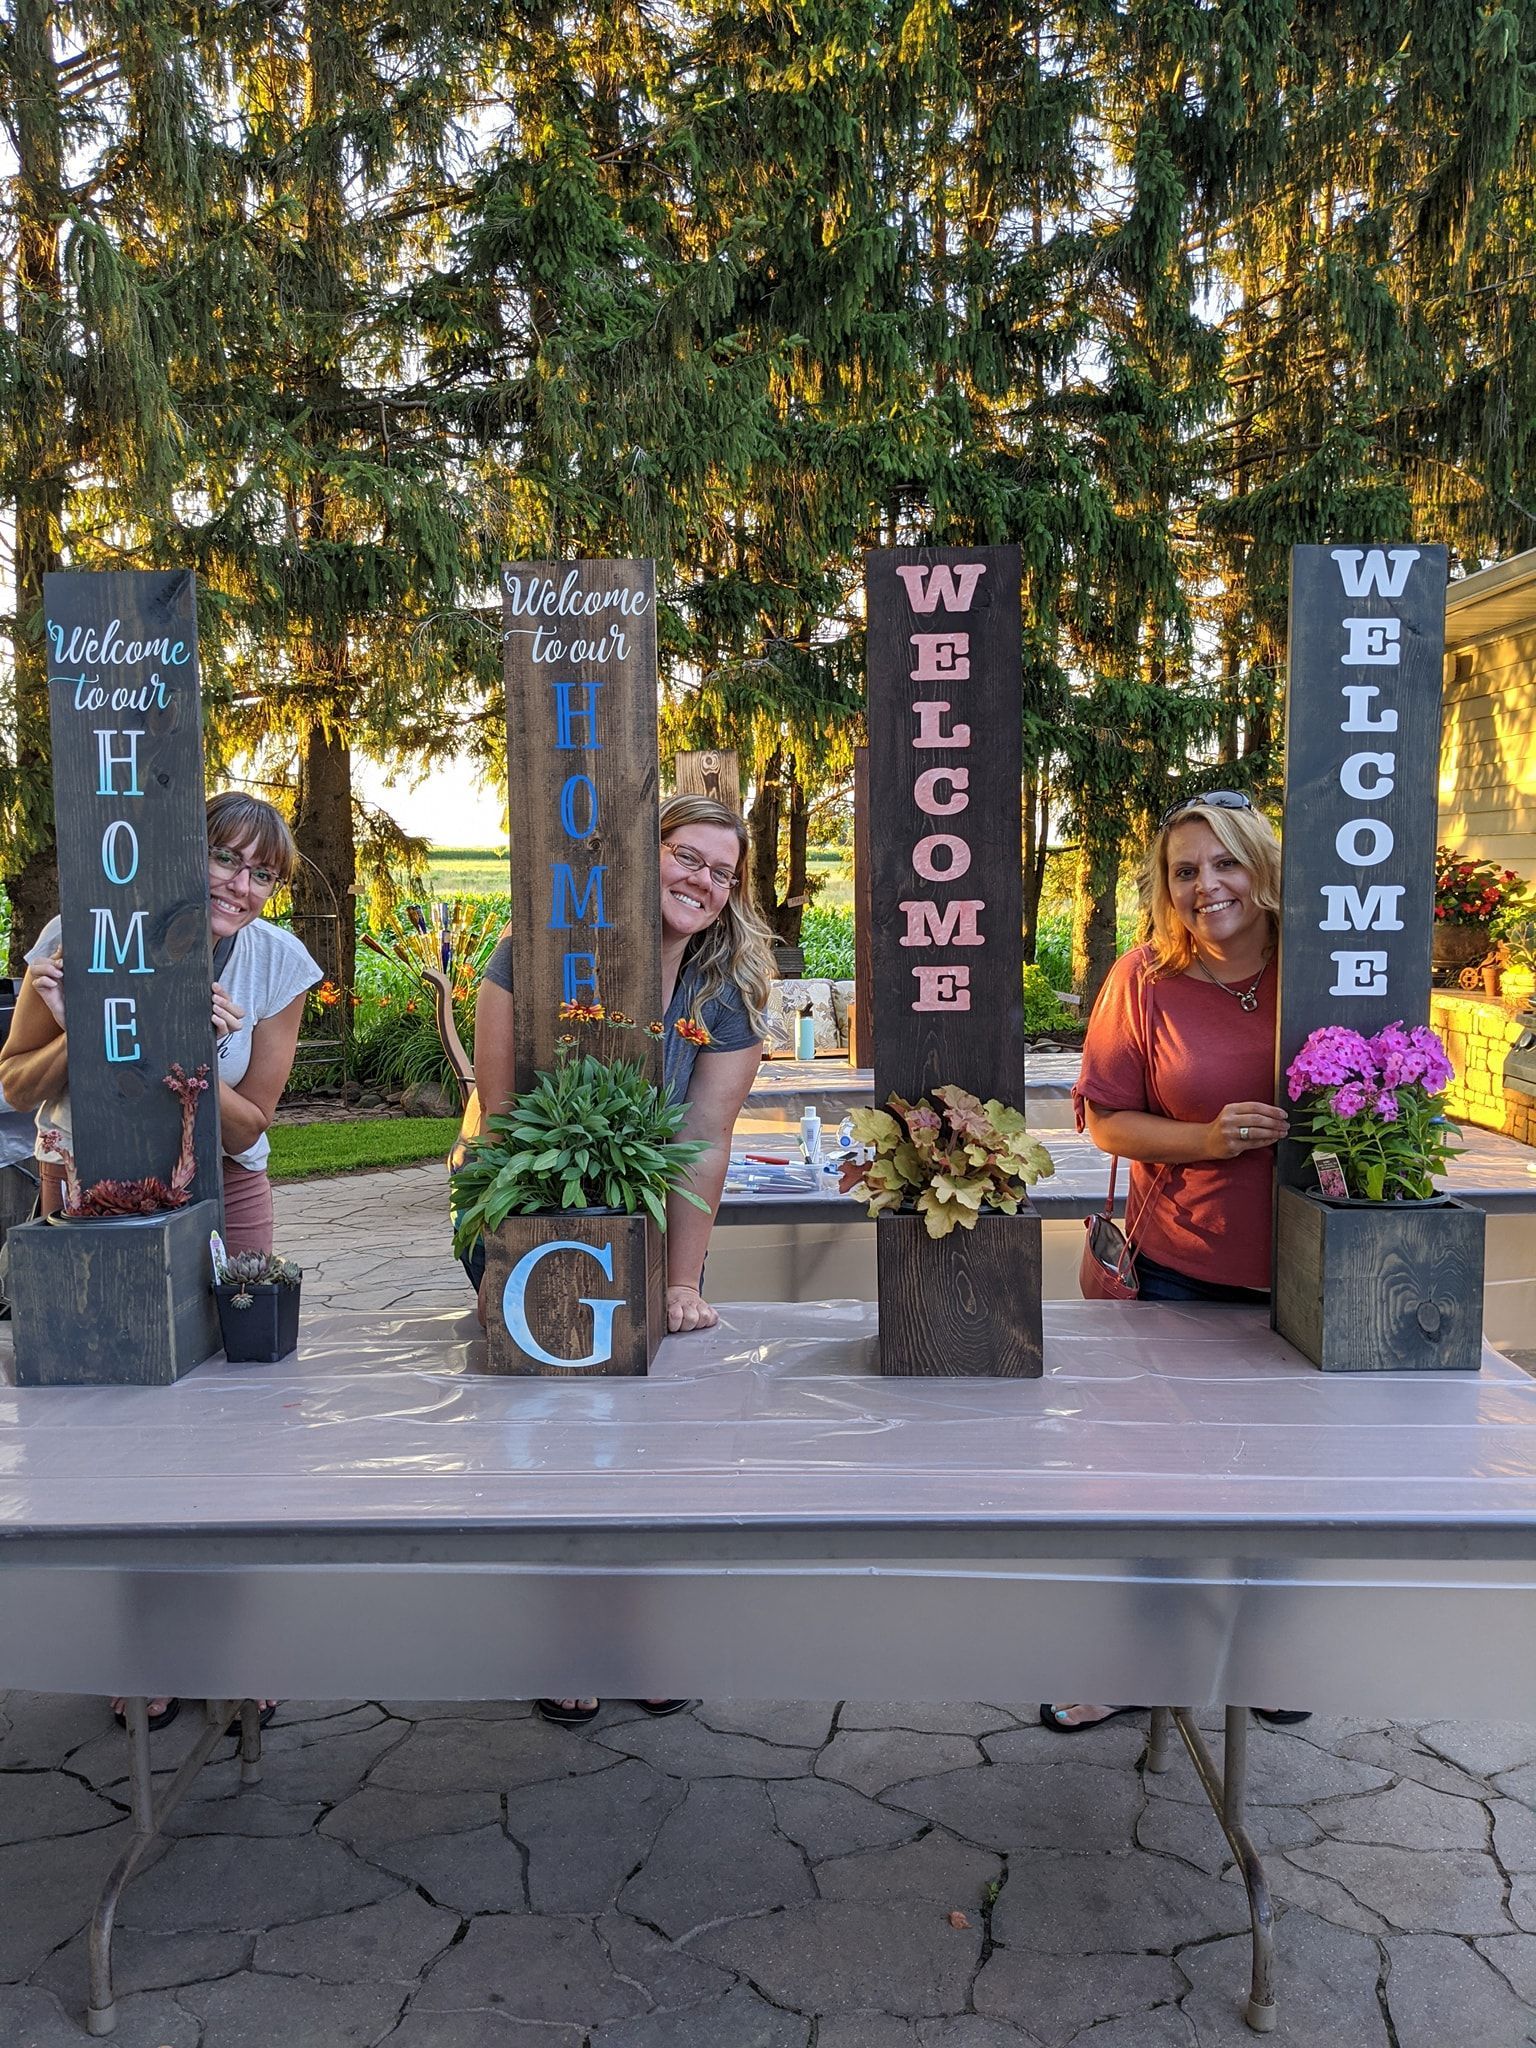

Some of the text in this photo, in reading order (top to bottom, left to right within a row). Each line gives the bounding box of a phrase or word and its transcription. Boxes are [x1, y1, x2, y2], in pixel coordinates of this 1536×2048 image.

[504, 569, 651, 616] Welcome
[47, 619, 190, 665] Welcome
[504, 624, 632, 664] to our
[48, 672, 171, 711] to our
[896, 563, 986, 1012] WELCOME
[1319, 549, 1421, 996] WELCOME
[88, 729, 155, 1063] HOME
[502, 1240, 627, 1368] G
